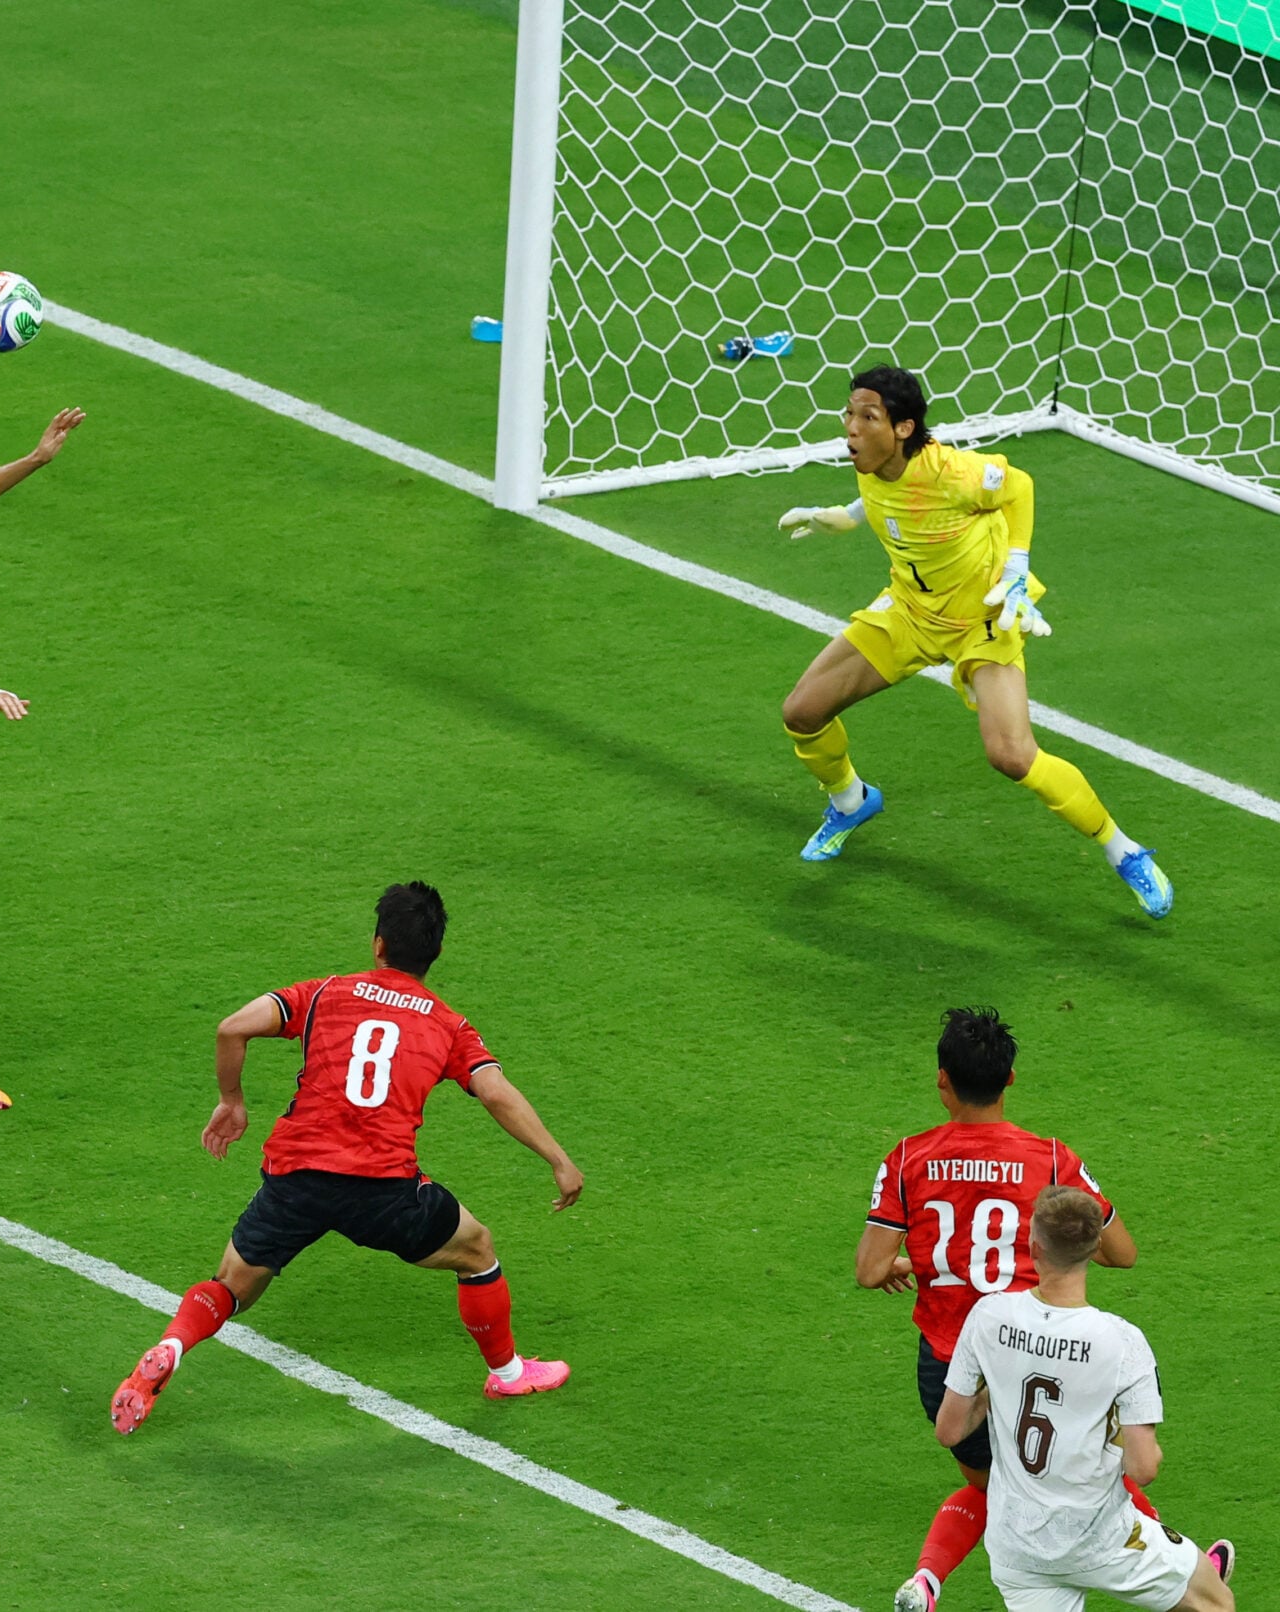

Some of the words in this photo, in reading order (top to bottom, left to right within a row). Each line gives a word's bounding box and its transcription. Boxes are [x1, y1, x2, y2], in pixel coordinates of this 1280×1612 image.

[907, 562, 933, 592] 1
[352, 981, 434, 1015] SEUNGHO
[345, 1019, 400, 1108] 8
[926, 1159, 1024, 1184] HYEONGYU
[924, 1198, 1020, 1294] 18
[998, 1324, 1091, 1363] CHALOUPEK
[1015, 1372, 1063, 1479] 6
